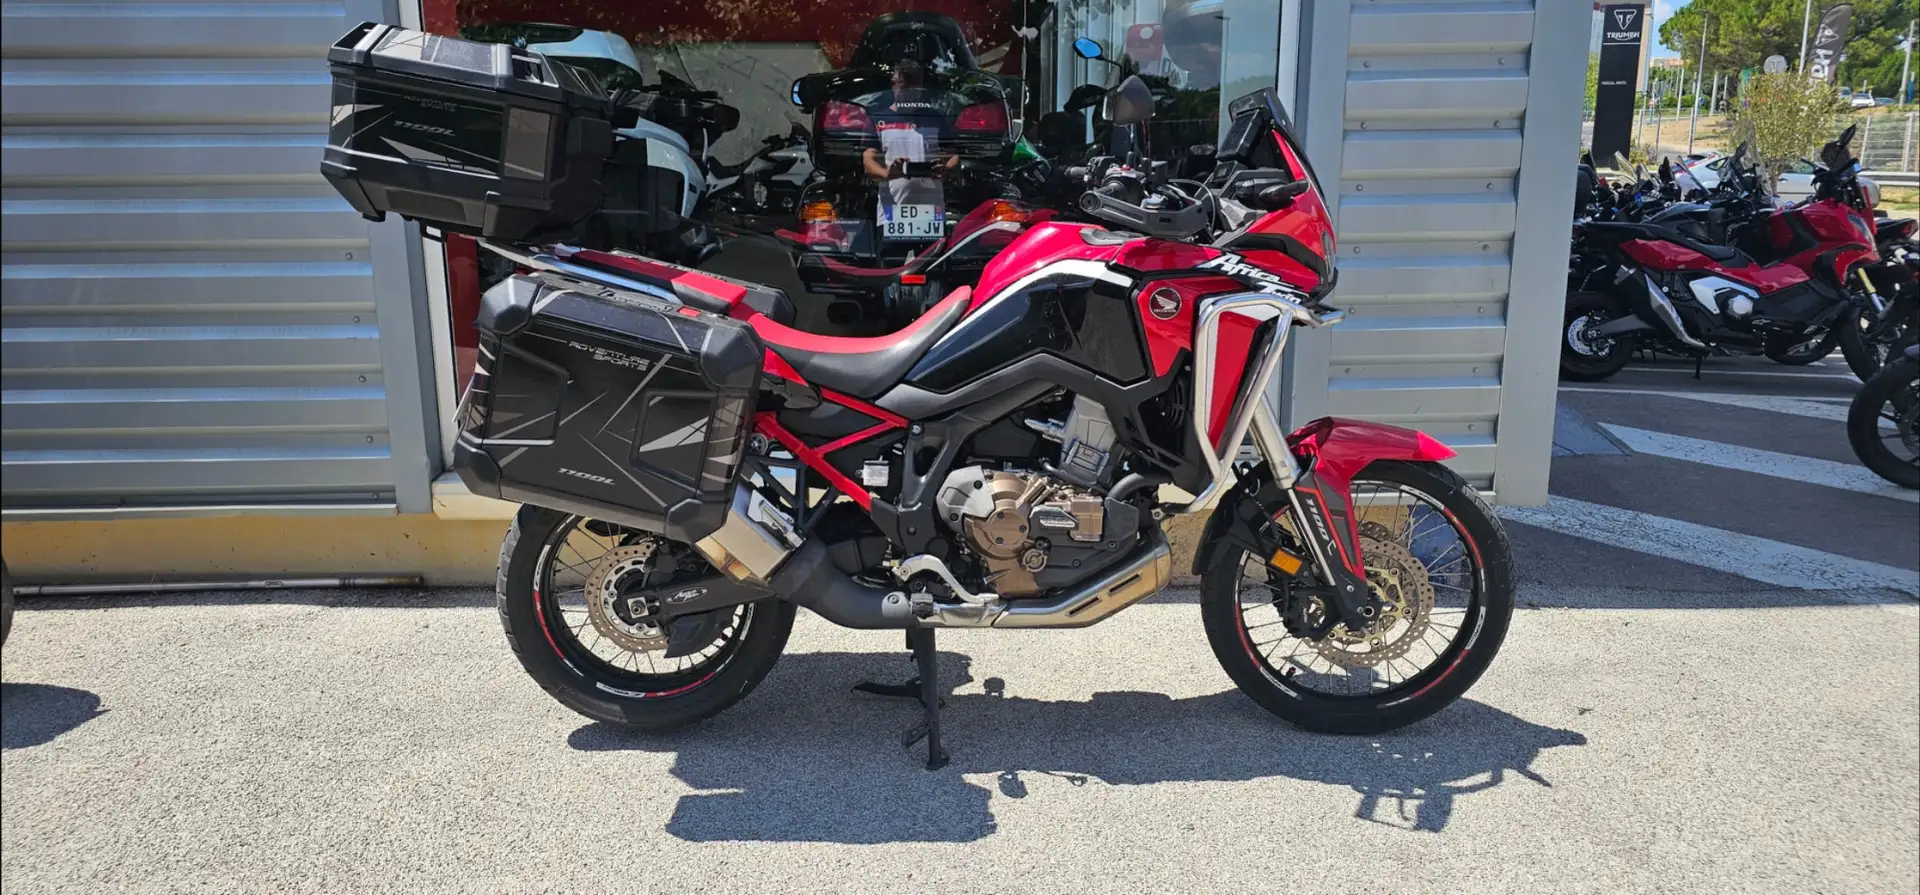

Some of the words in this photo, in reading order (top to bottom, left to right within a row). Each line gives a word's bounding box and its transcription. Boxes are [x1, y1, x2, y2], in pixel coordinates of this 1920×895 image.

[1606, 31, 1640, 41] TRIUMPH
[392, 119, 457, 137] 1100L
[900, 205, 918, 219] ED
[887, 221, 941, 235] 881-JW
[1196, 252, 1288, 283] Africa
[1256, 280, 1310, 305] Twin
[568, 340, 651, 366] ADVENTURE
[592, 353, 648, 372] SPORTS
[557, 467, 616, 486] 1100L
